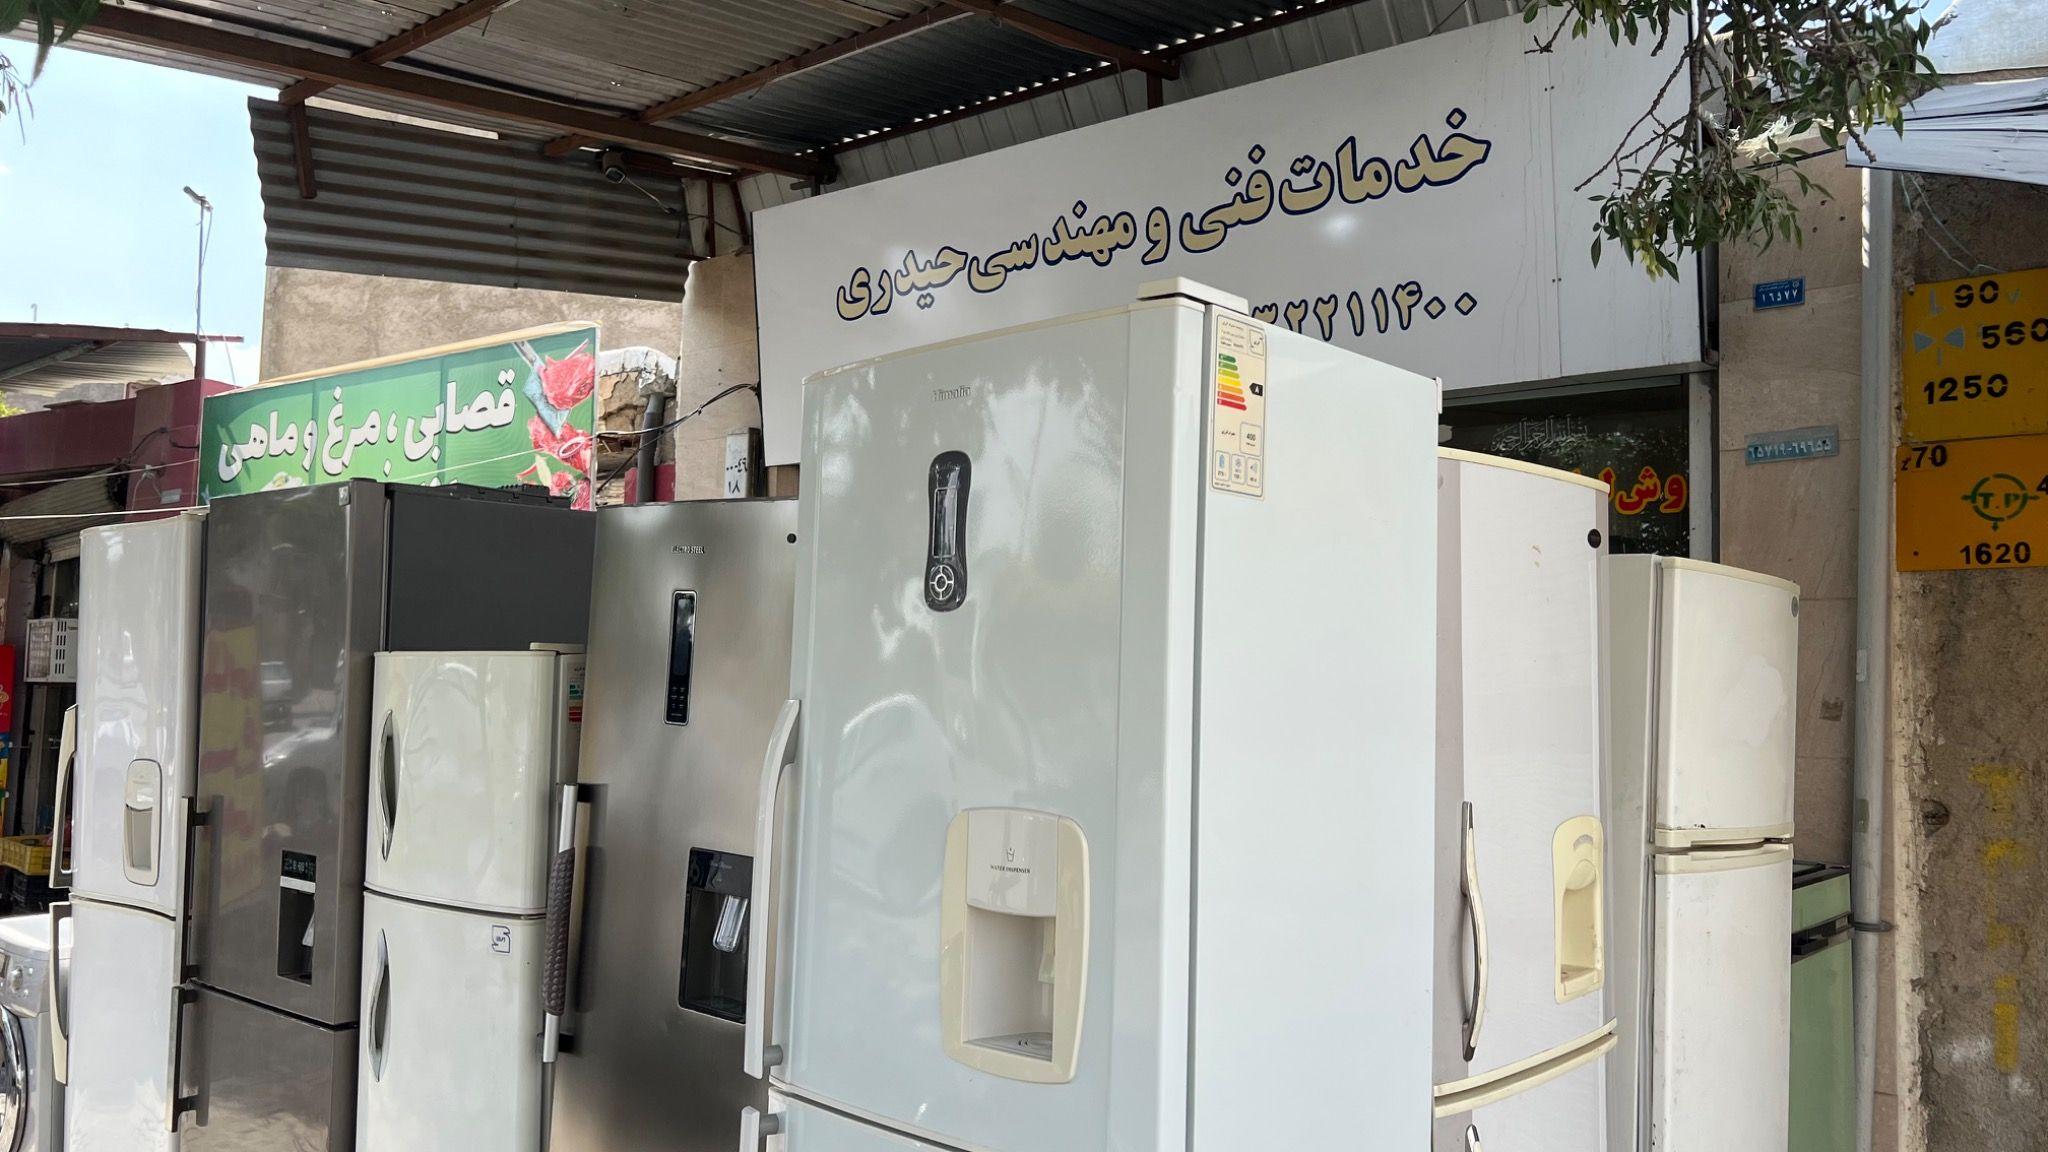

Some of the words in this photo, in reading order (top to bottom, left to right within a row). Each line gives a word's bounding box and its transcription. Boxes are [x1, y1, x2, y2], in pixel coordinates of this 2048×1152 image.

[1279, 107, 1492, 216] خدمات
[1178, 143, 1274, 253] فنی
[967, 200, 1139, 293] مهندسی
[1140, 205, 1173, 264] و
[835, 245, 968, 321] حیدری
[1954, 280, 1999, 308] 90
[1981, 317, 2048, 350] 560
[1923, 373, 2009, 405] 1250
[216, 409, 299, 484] ماهی
[302, 419, 318, 472] و
[321, 385, 381, 477] مرغ
[1959, 541, 2032, 566] 1620
